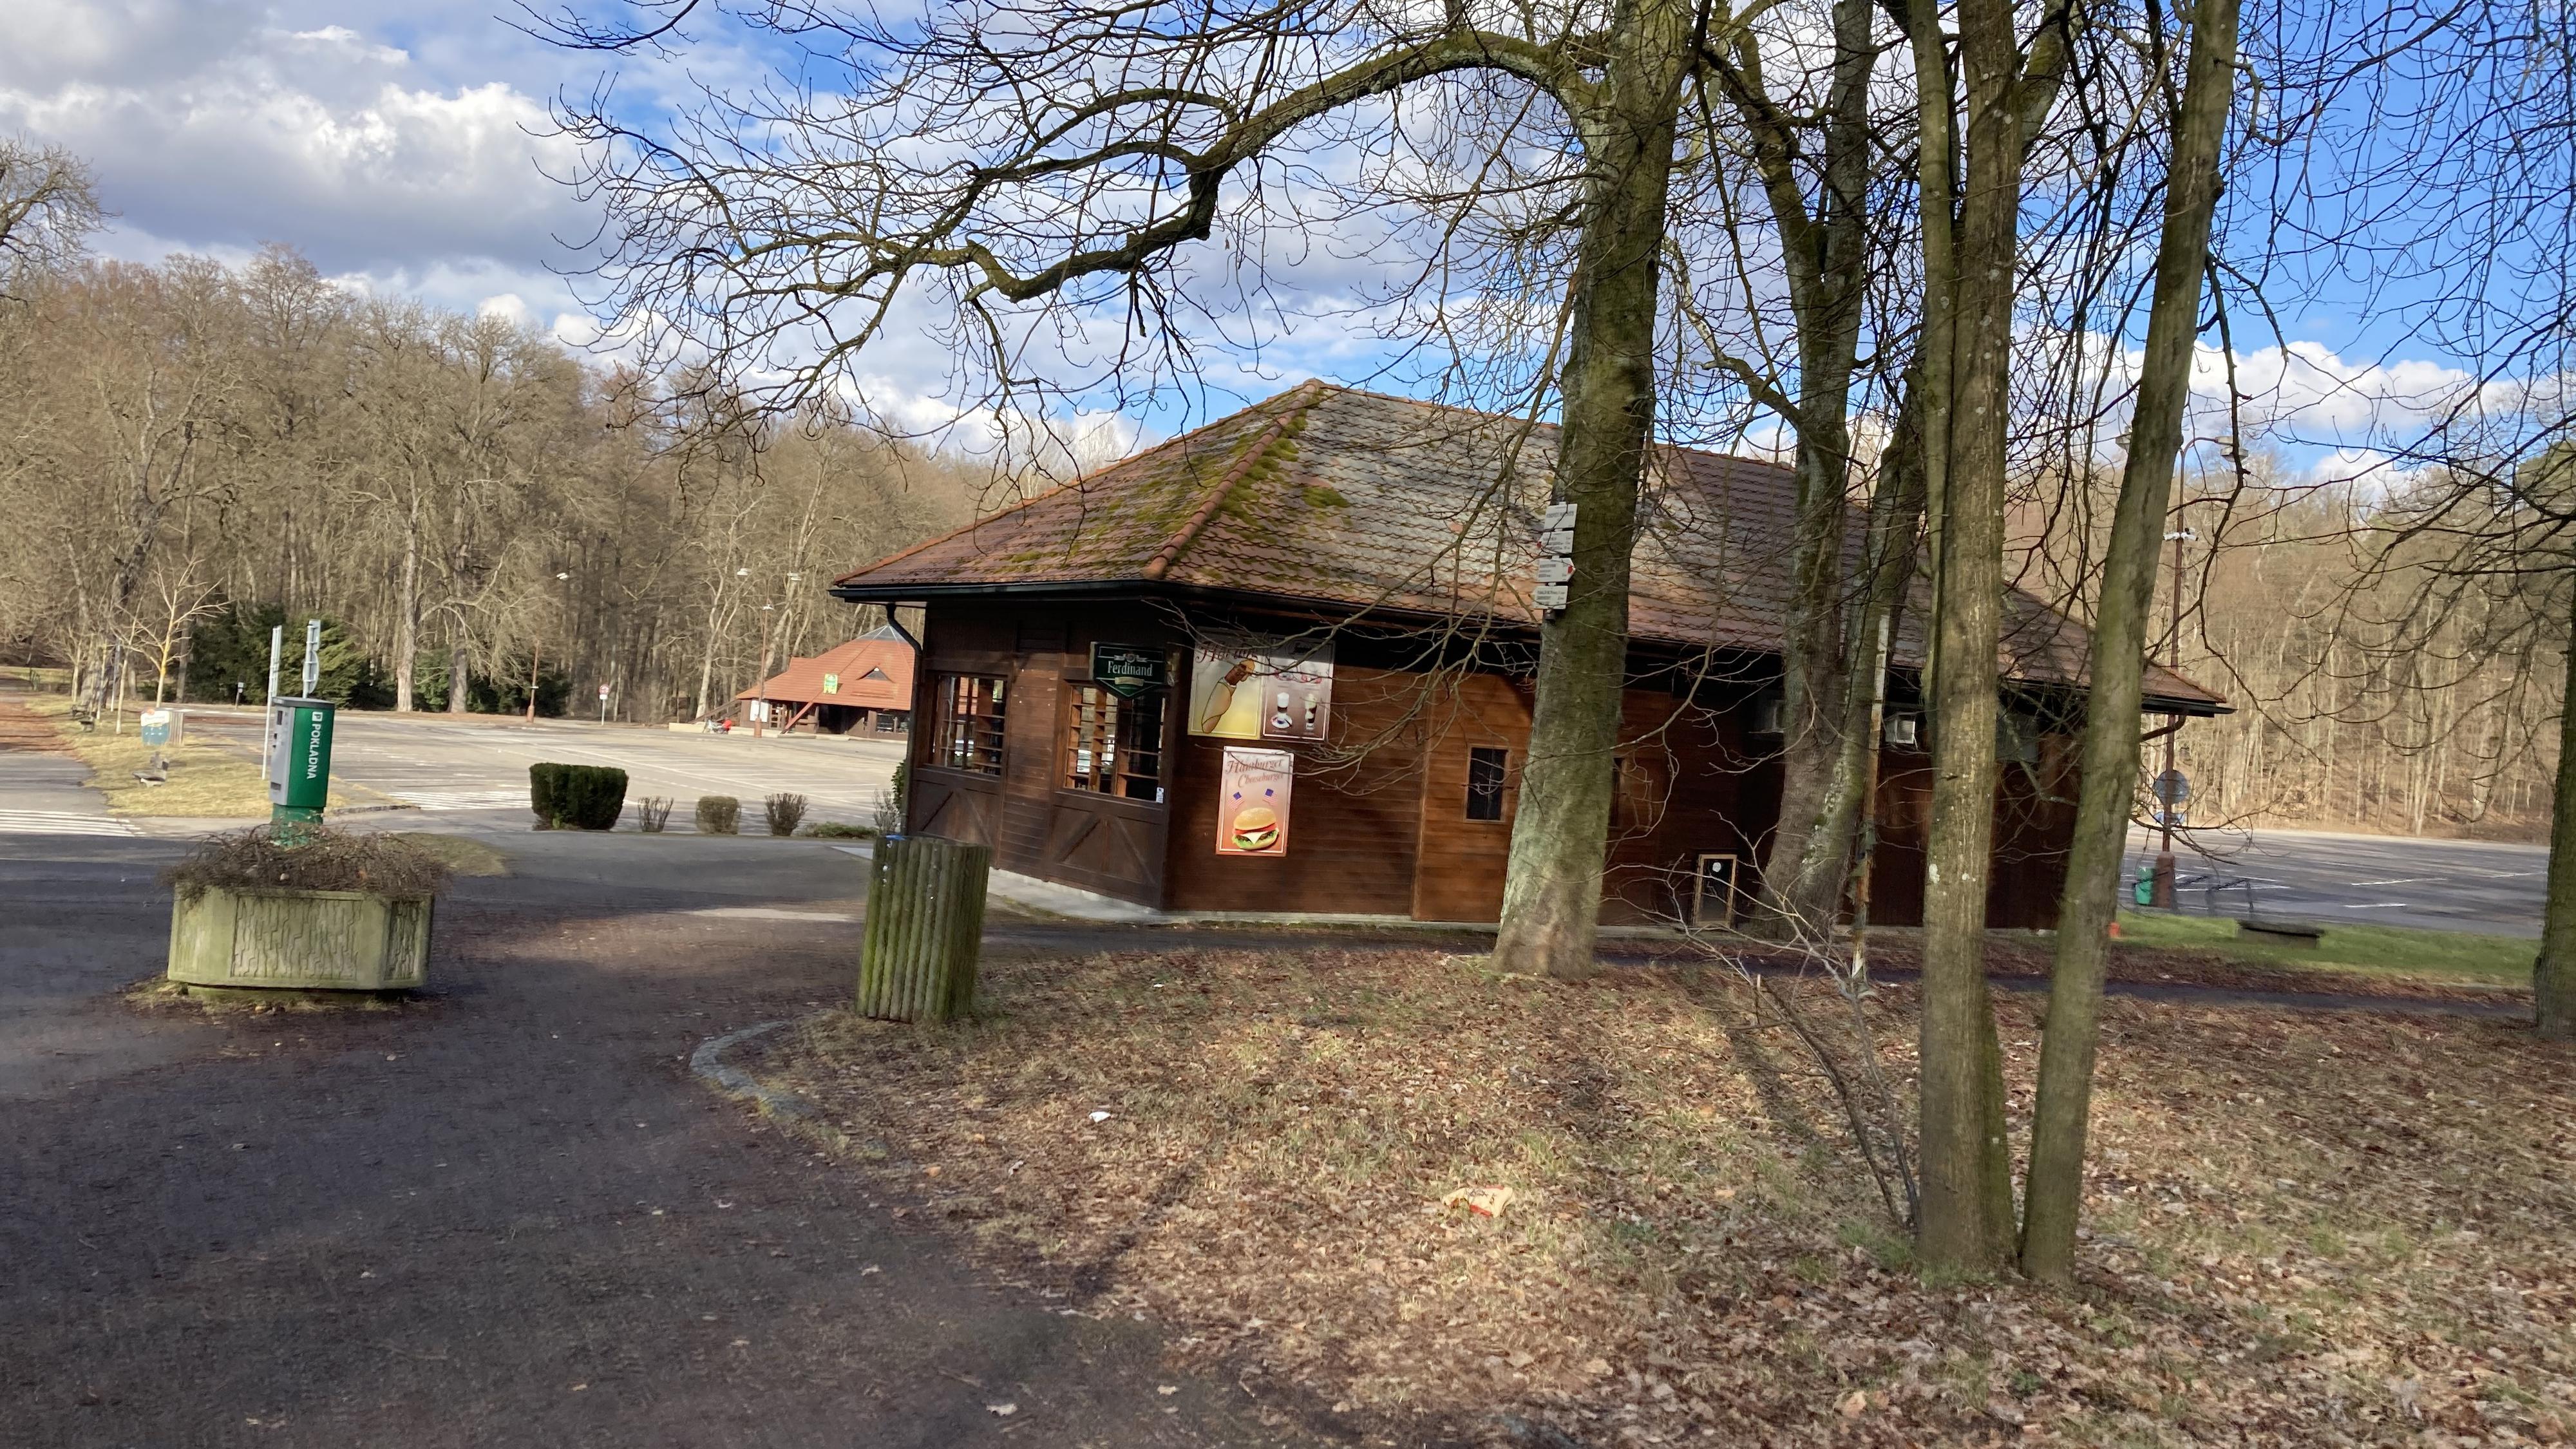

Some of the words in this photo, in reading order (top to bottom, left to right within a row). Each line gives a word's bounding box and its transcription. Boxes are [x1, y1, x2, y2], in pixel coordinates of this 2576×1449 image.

[1108, 661, 1152, 676] Ferdinand
[307, 723, 321, 779] POKLADNA
[1226, 758, 1284, 774] Hamburger
